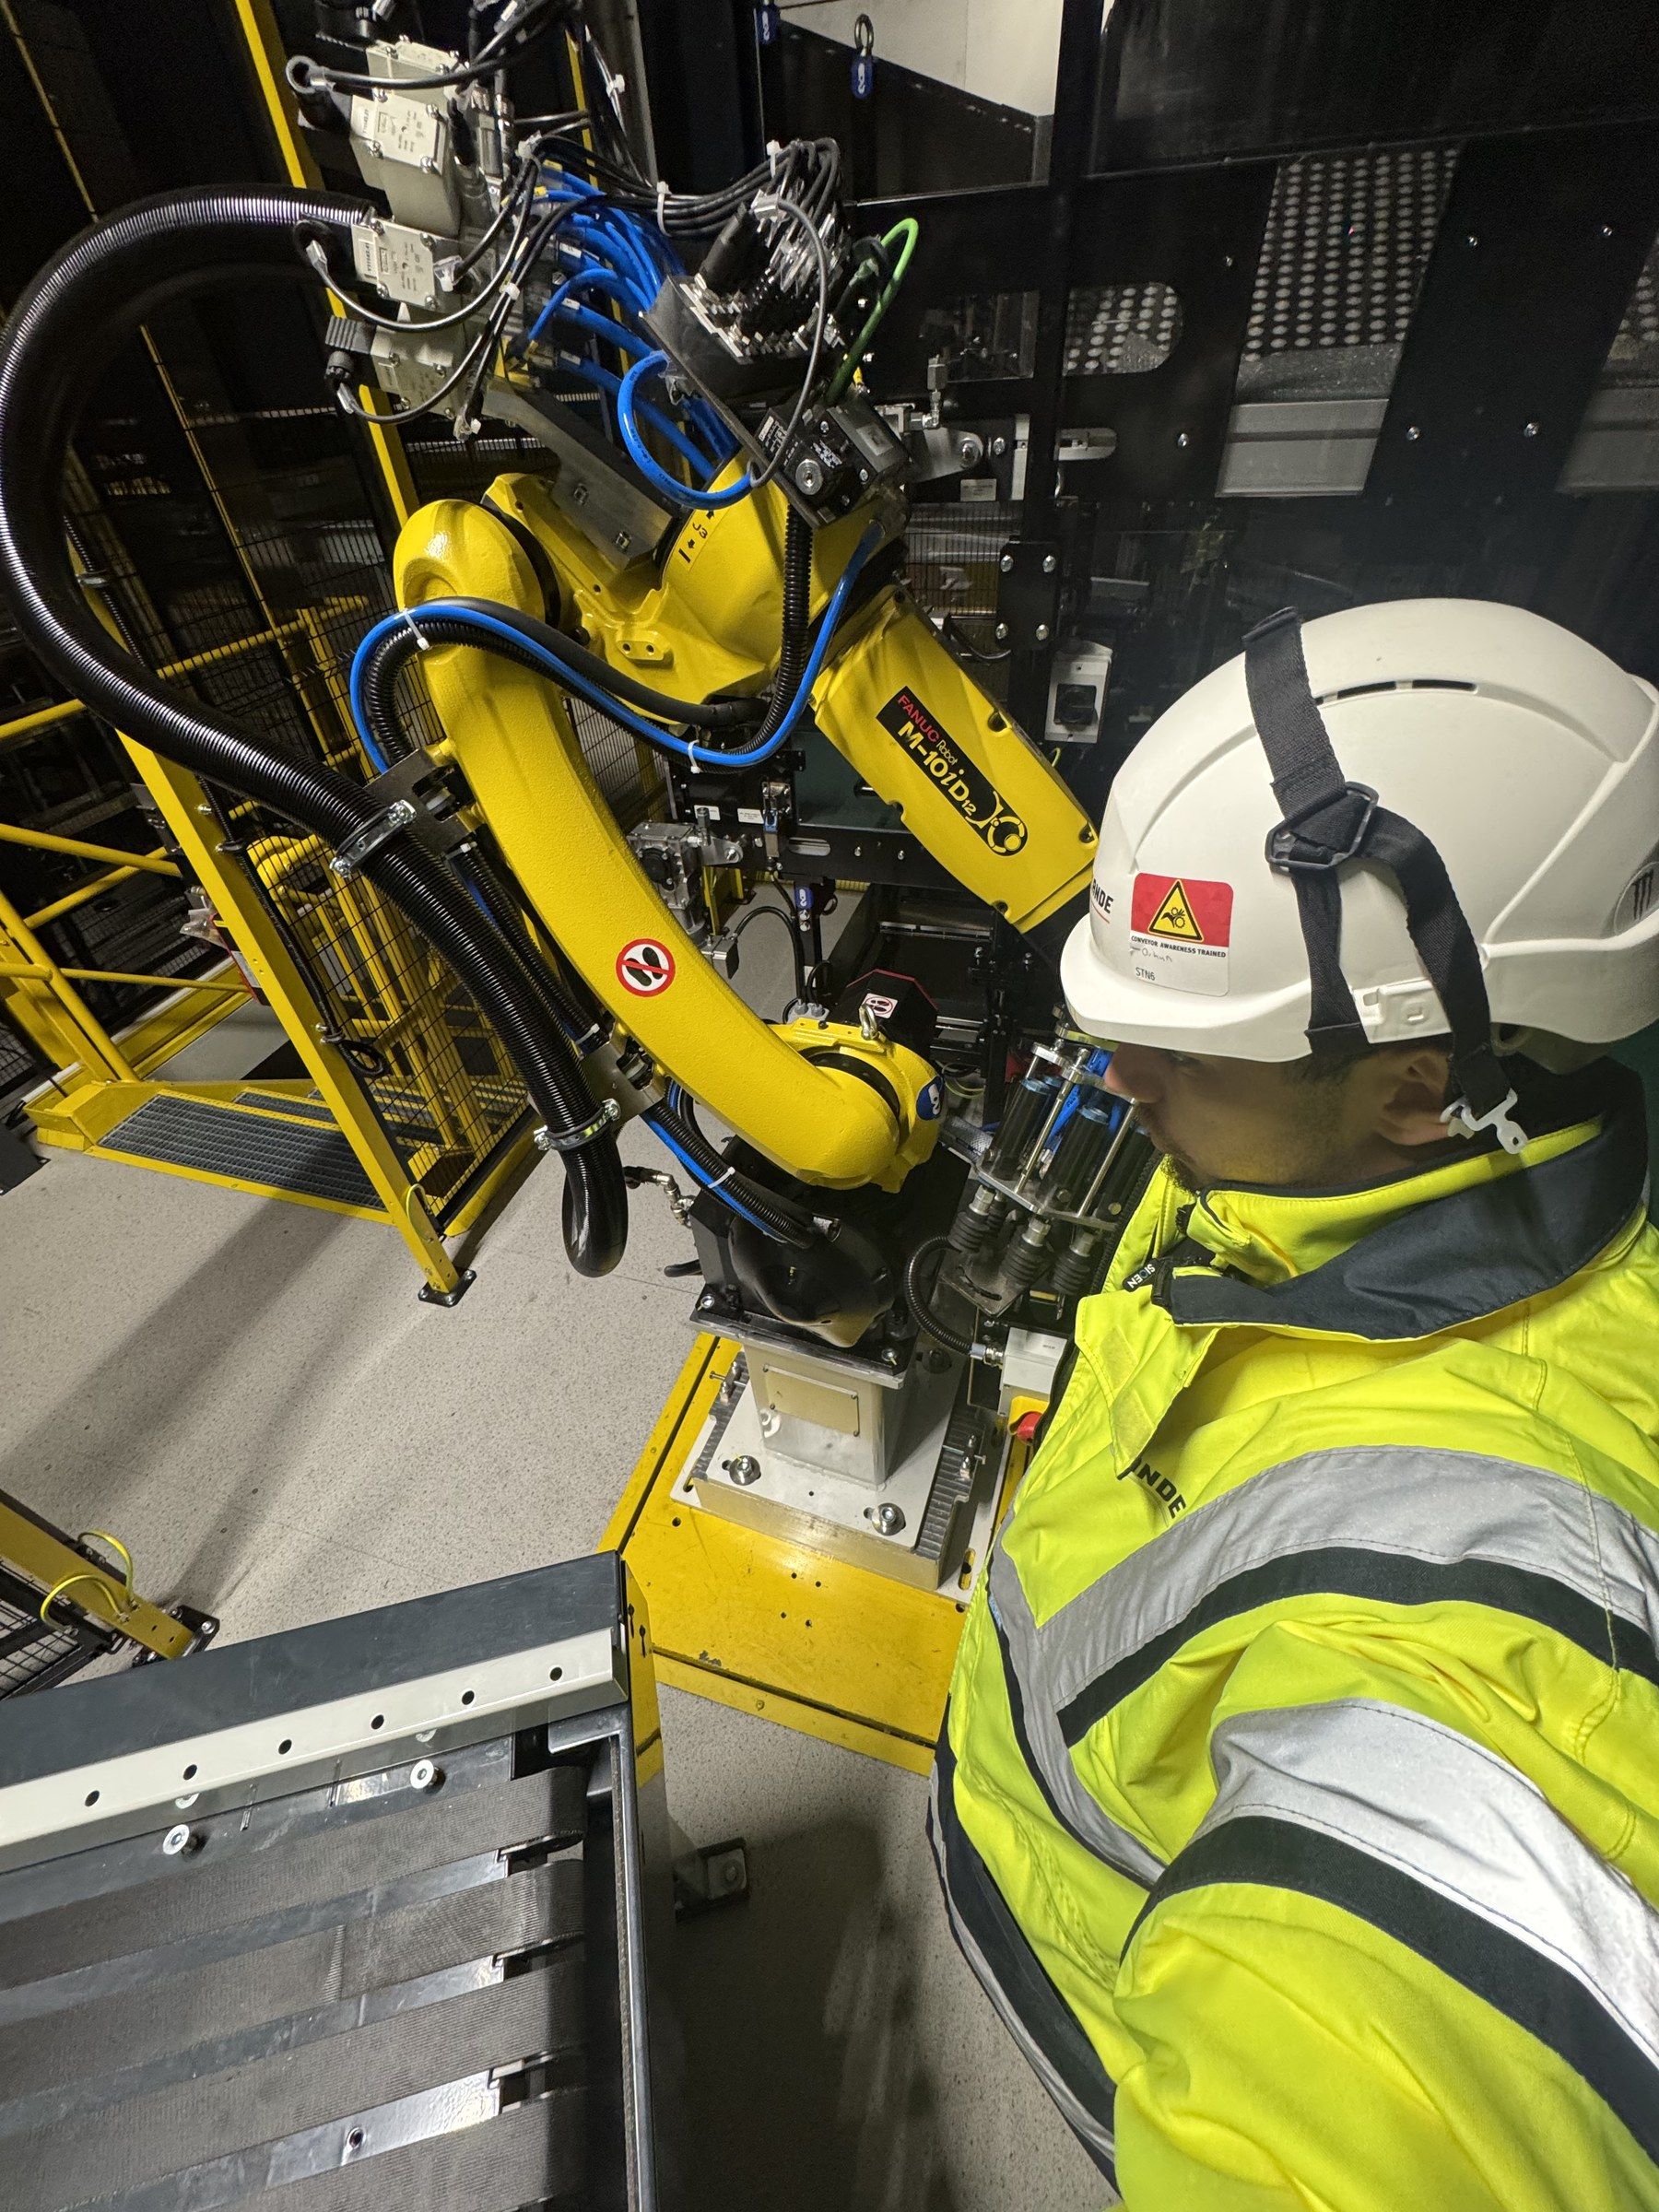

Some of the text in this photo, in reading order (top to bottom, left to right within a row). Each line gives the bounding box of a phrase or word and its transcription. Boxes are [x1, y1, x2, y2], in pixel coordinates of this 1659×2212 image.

[897, 695, 959, 766] FANUC Robot
[1131, 935, 1227, 959] CONVEYOR AWARENESS TRAINED
[1135, 967, 1156, 982] STN6
[1127, 1264, 1156, 1289] SIOEN
